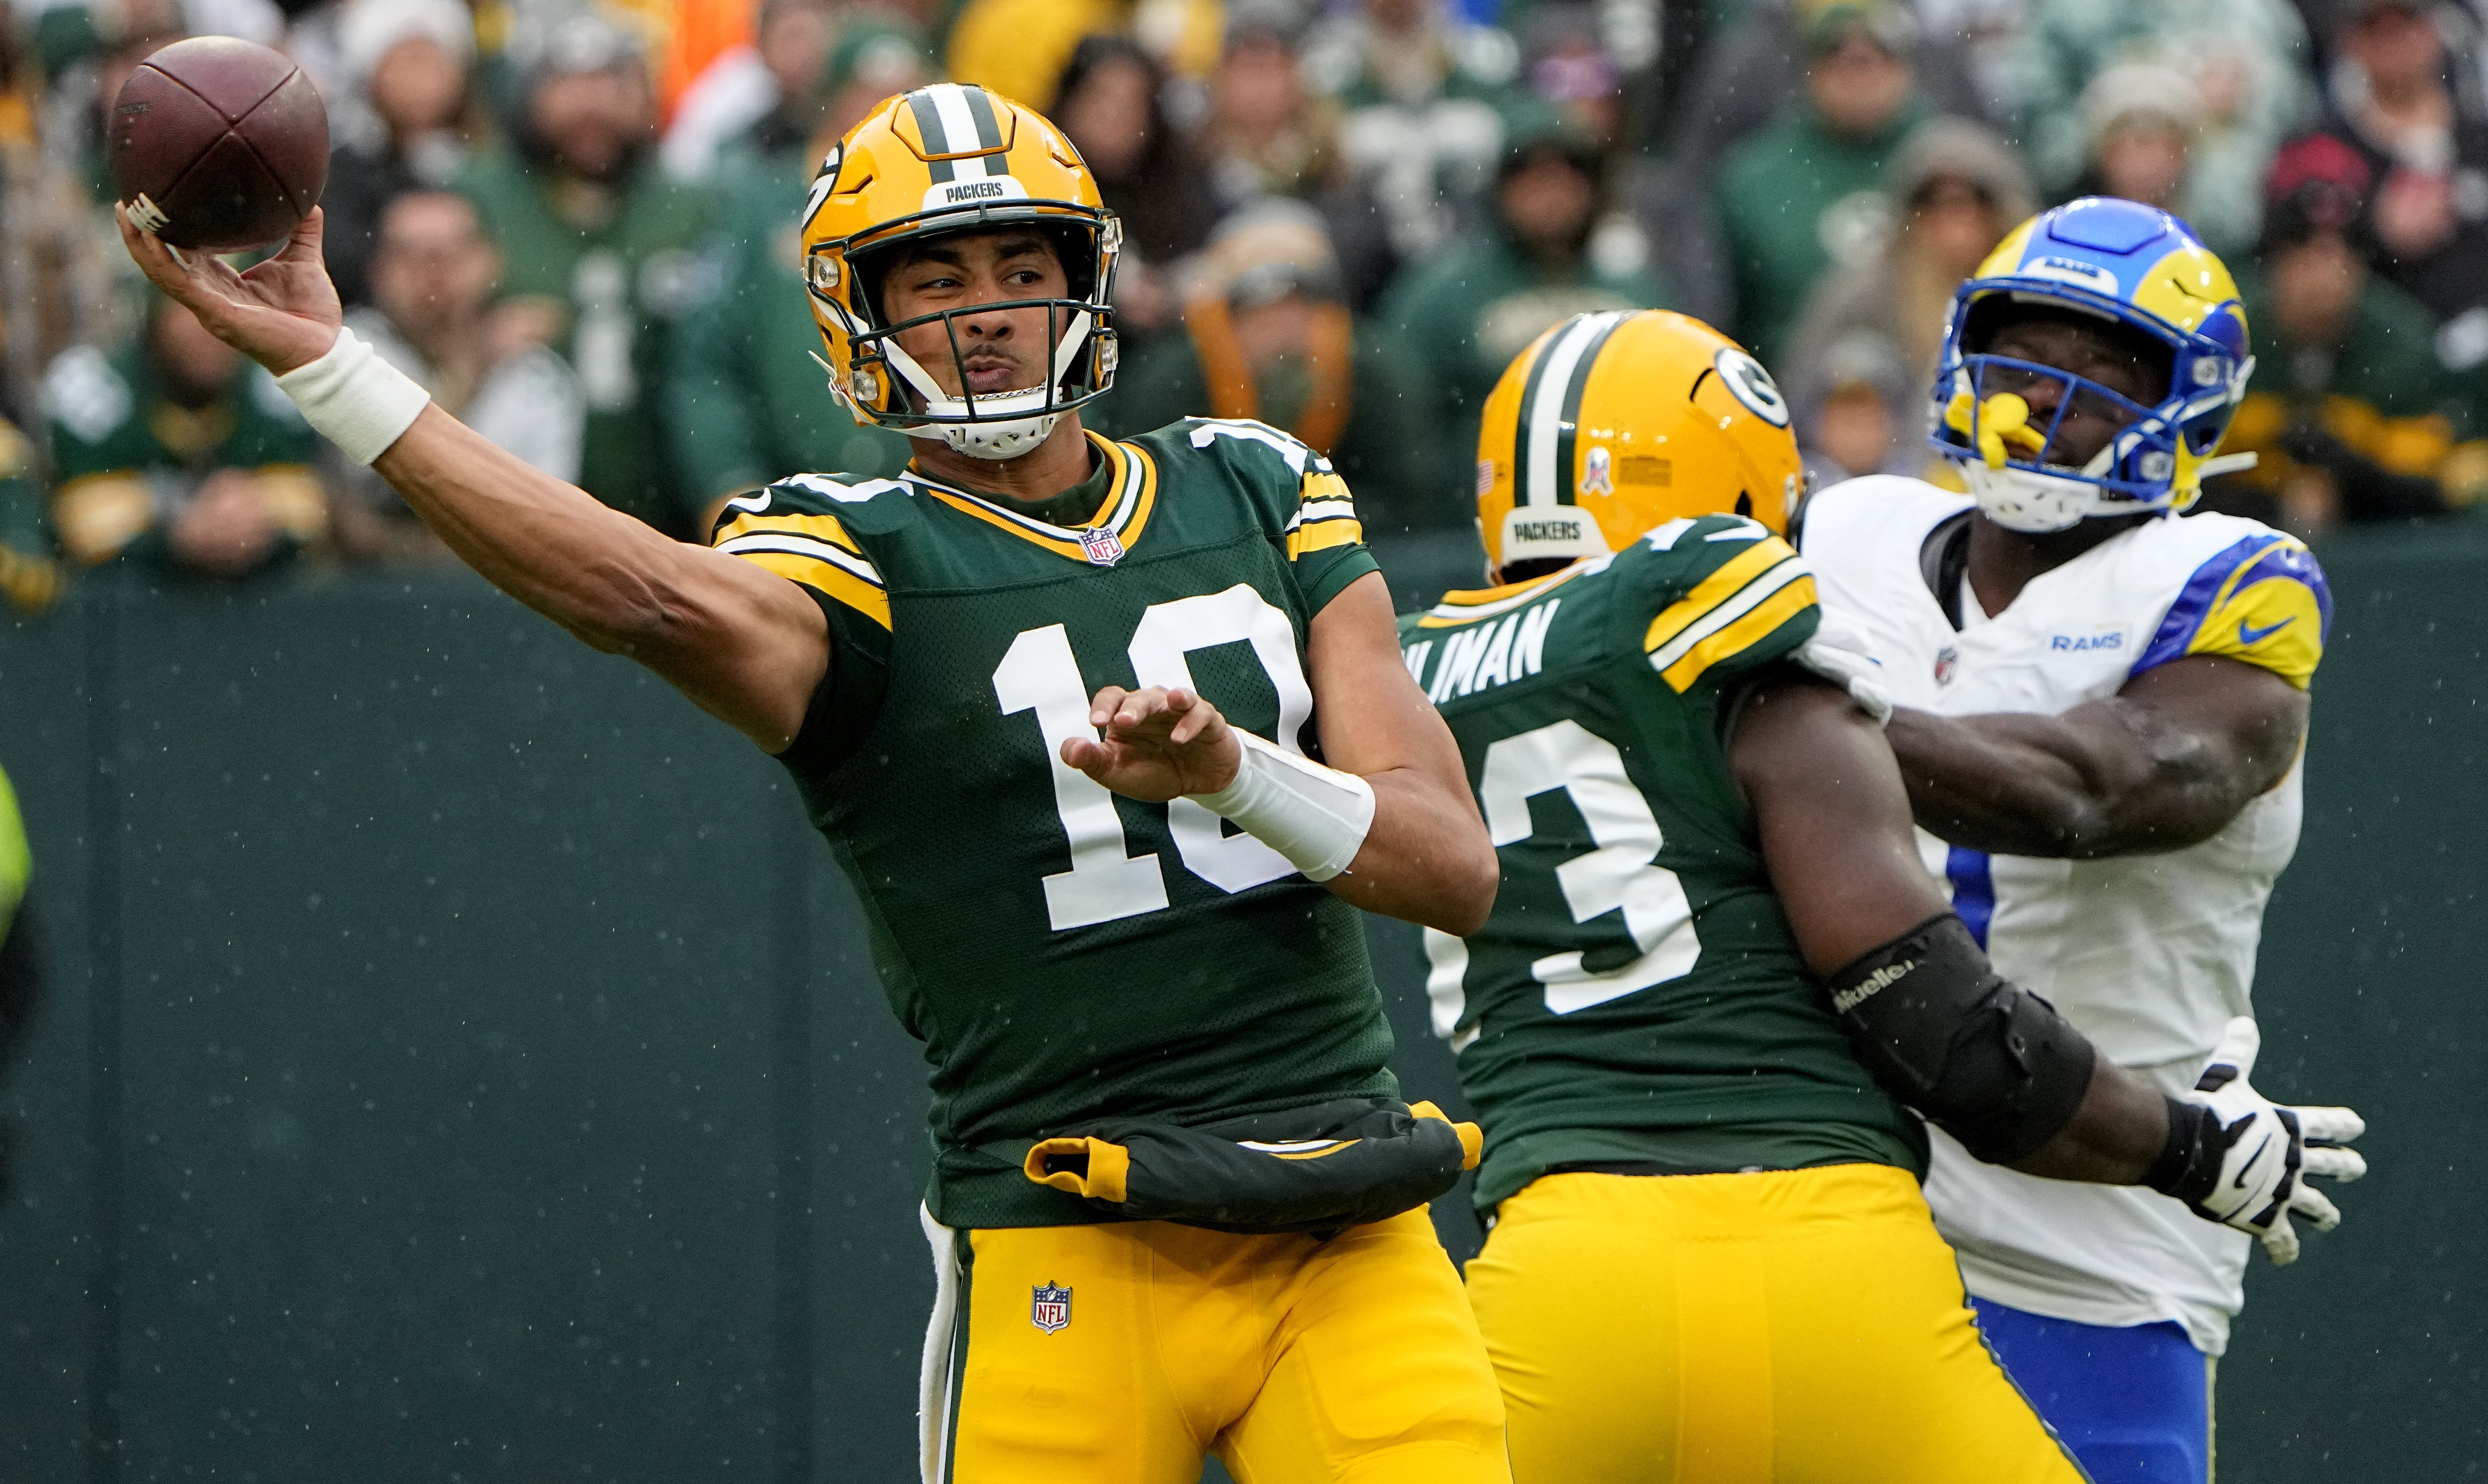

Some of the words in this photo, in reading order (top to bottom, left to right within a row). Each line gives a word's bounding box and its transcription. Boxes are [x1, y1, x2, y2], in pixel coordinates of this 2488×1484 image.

[945, 182, 1003, 203] PACKERS
[1514, 521, 1581, 541] PACKERS
[1090, 540, 1119, 558] NFL
[2052, 632, 2122, 650] RAMS
[992, 582, 1313, 931] 10
[1423, 720, 1702, 1054] 3
[1037, 1304, 1064, 1325] NFL
